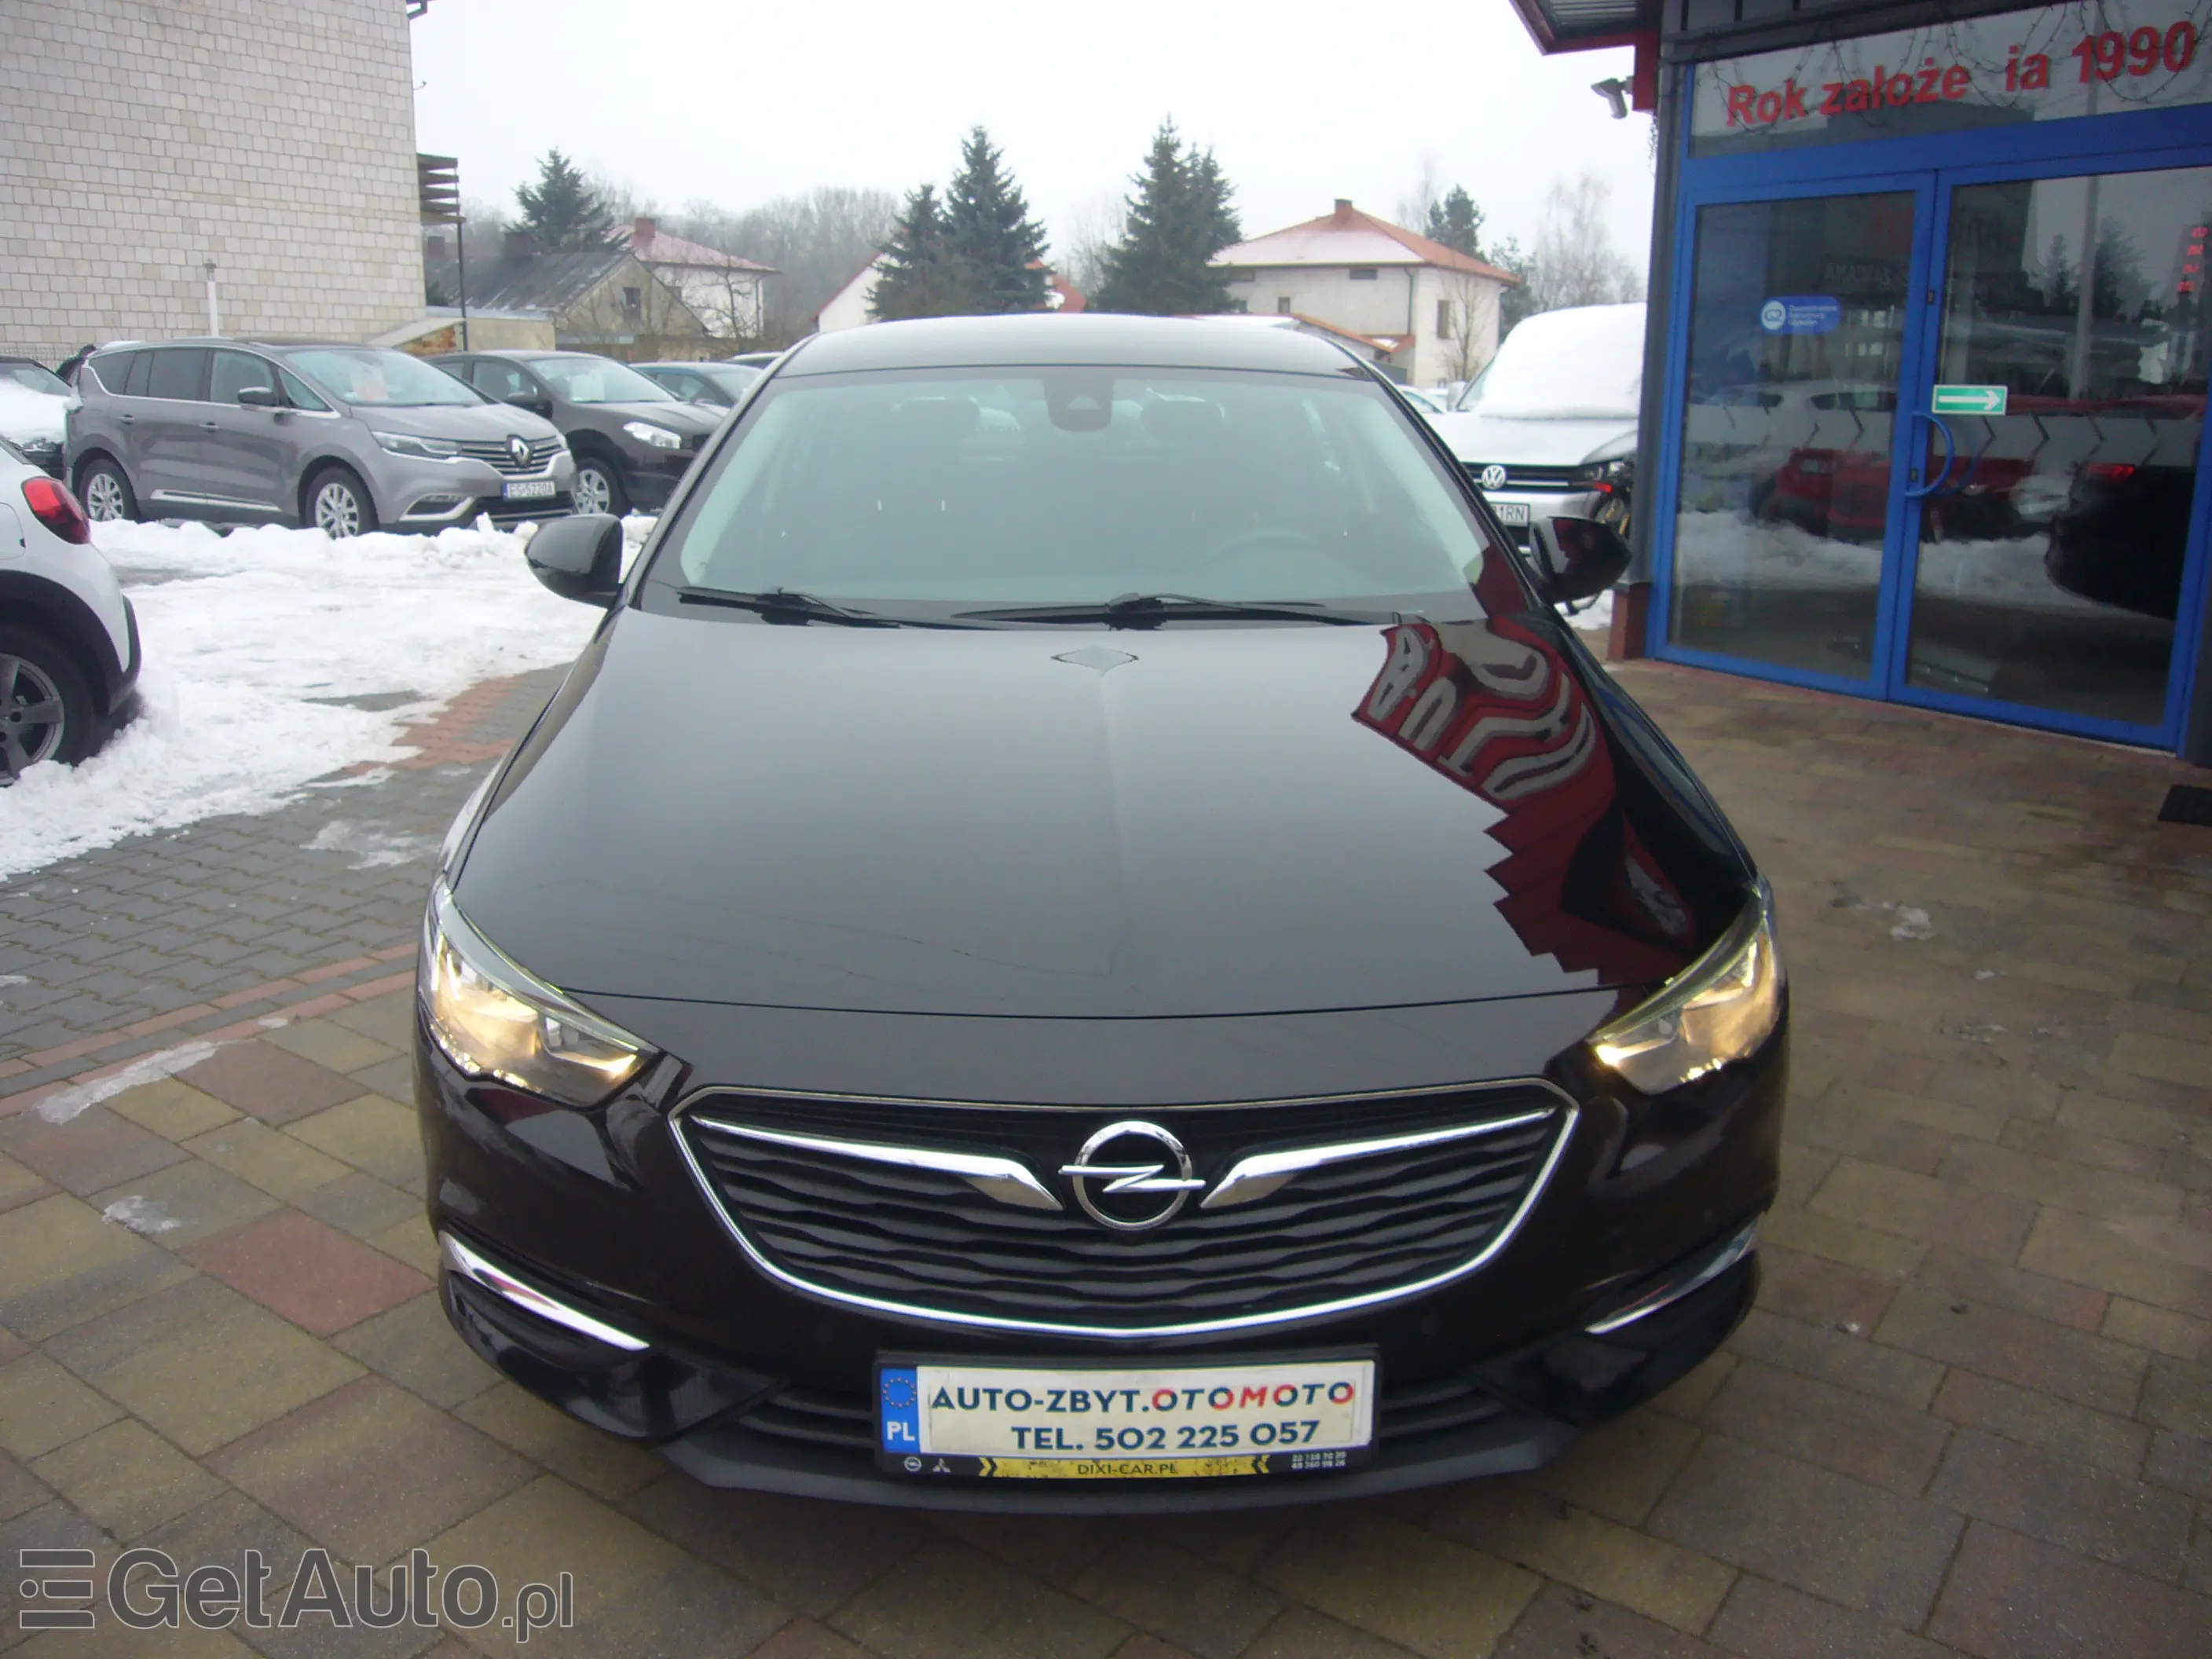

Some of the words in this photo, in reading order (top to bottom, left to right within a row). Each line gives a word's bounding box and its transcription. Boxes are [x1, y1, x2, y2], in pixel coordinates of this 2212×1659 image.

[1727, 77, 1808, 127] Rok
[2072, 20, 2197, 84] 1990
[932, 1382, 1354, 1414] AUTO-ZBYT.OTOMOTO
[886, 1420, 916, 1442] PL
[1011, 1426, 1084, 1451] TEL.
[1095, 1426, 1166, 1451] 502
[1177, 1424, 1240, 1449] 225
[1250, 1419, 1320, 1446] 057
[1077, 1463, 1177, 1475] DIXI-CAR.PL
